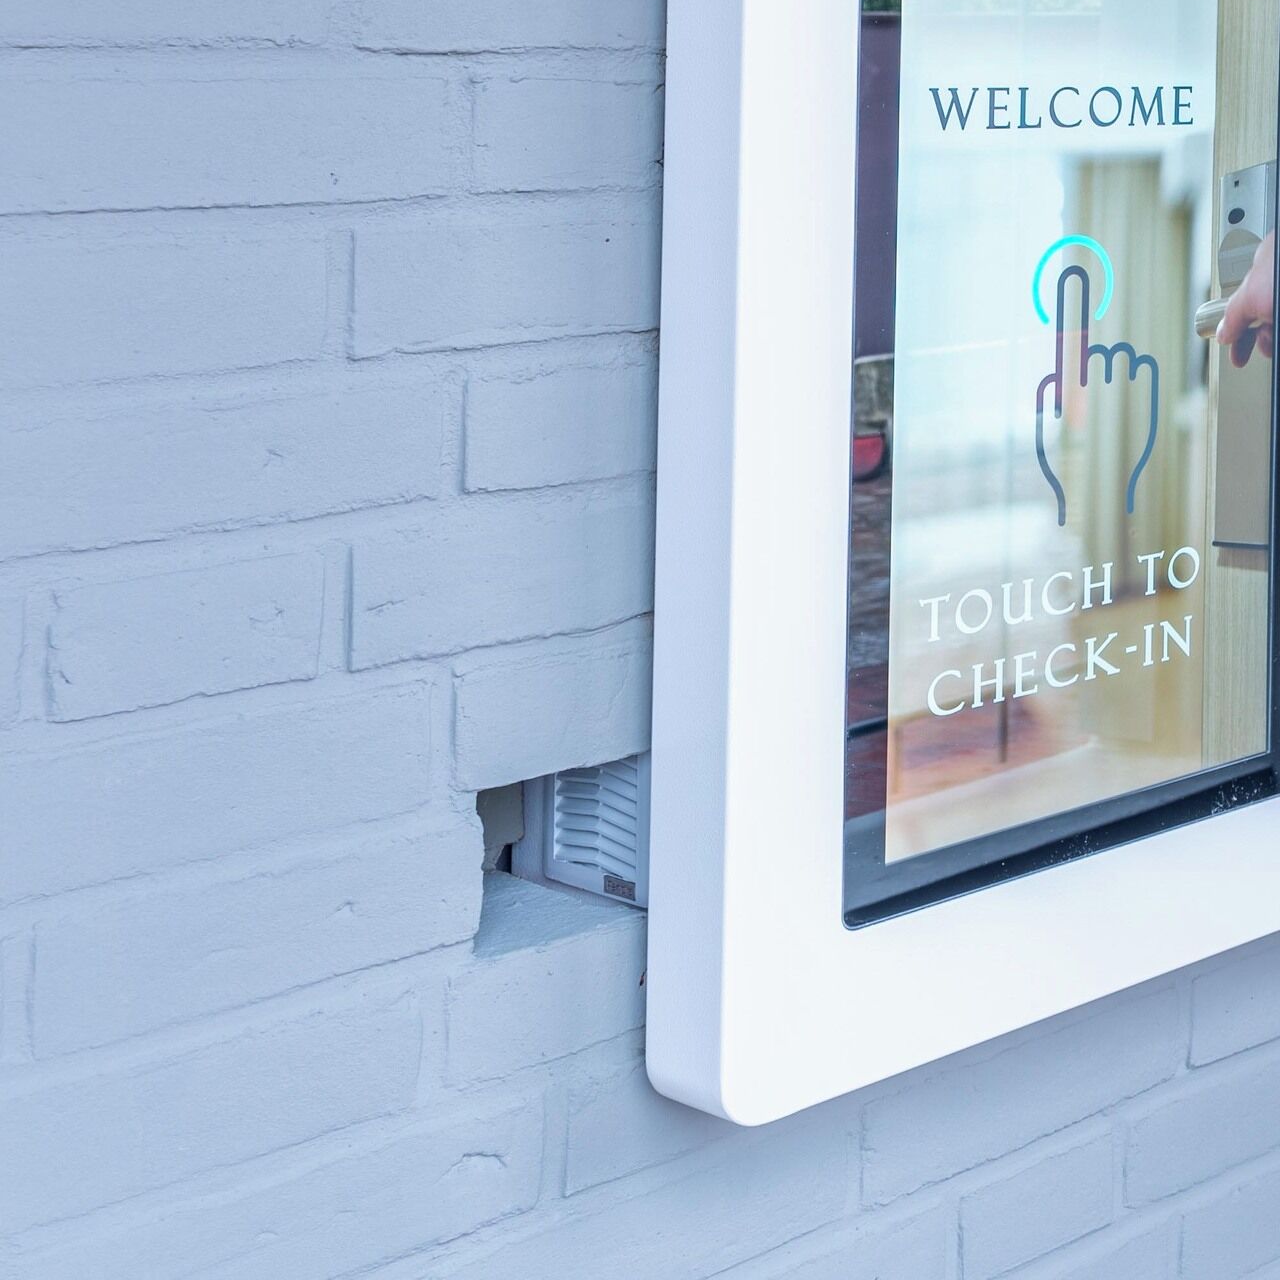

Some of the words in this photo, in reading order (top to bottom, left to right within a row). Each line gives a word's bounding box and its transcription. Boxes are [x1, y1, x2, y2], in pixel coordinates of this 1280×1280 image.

[929, 86, 1195, 132] WELCOME
[919, 562, 1115, 642] TOUCH
[1137, 546, 1201, 596] TO
[927, 616, 1193, 717] CHECK-IN
